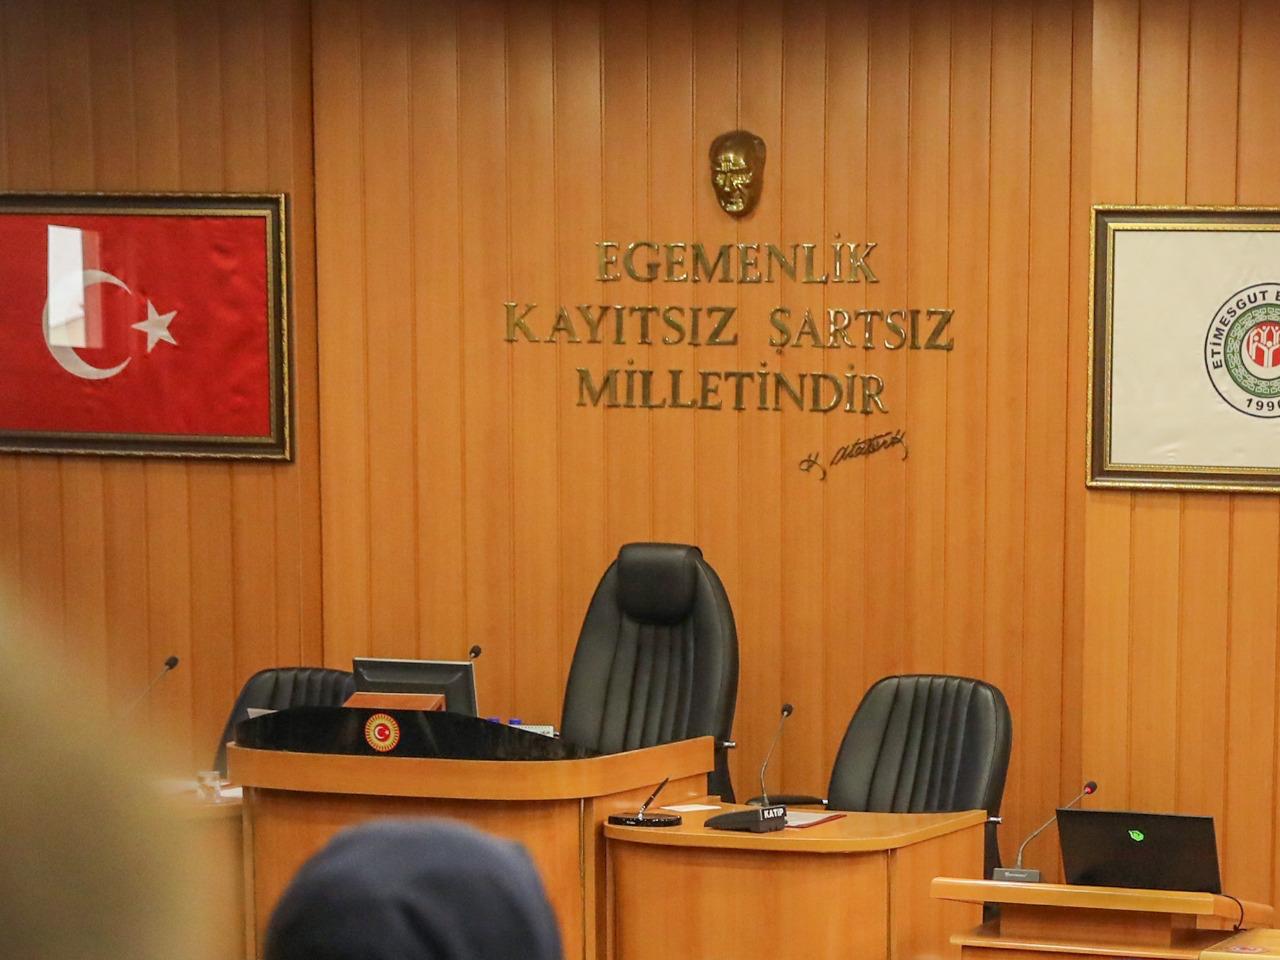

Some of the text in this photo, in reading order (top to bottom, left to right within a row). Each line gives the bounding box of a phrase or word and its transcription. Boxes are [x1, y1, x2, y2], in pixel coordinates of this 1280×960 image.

[595, 232, 879, 283] EGEMENLİK
[503, 301, 955, 356] KAYITSIZ ŞARTSIZ
[1210, 290, 1269, 370] ETİMESGUT
[575, 359, 889, 415] MİLLETİNDİR
